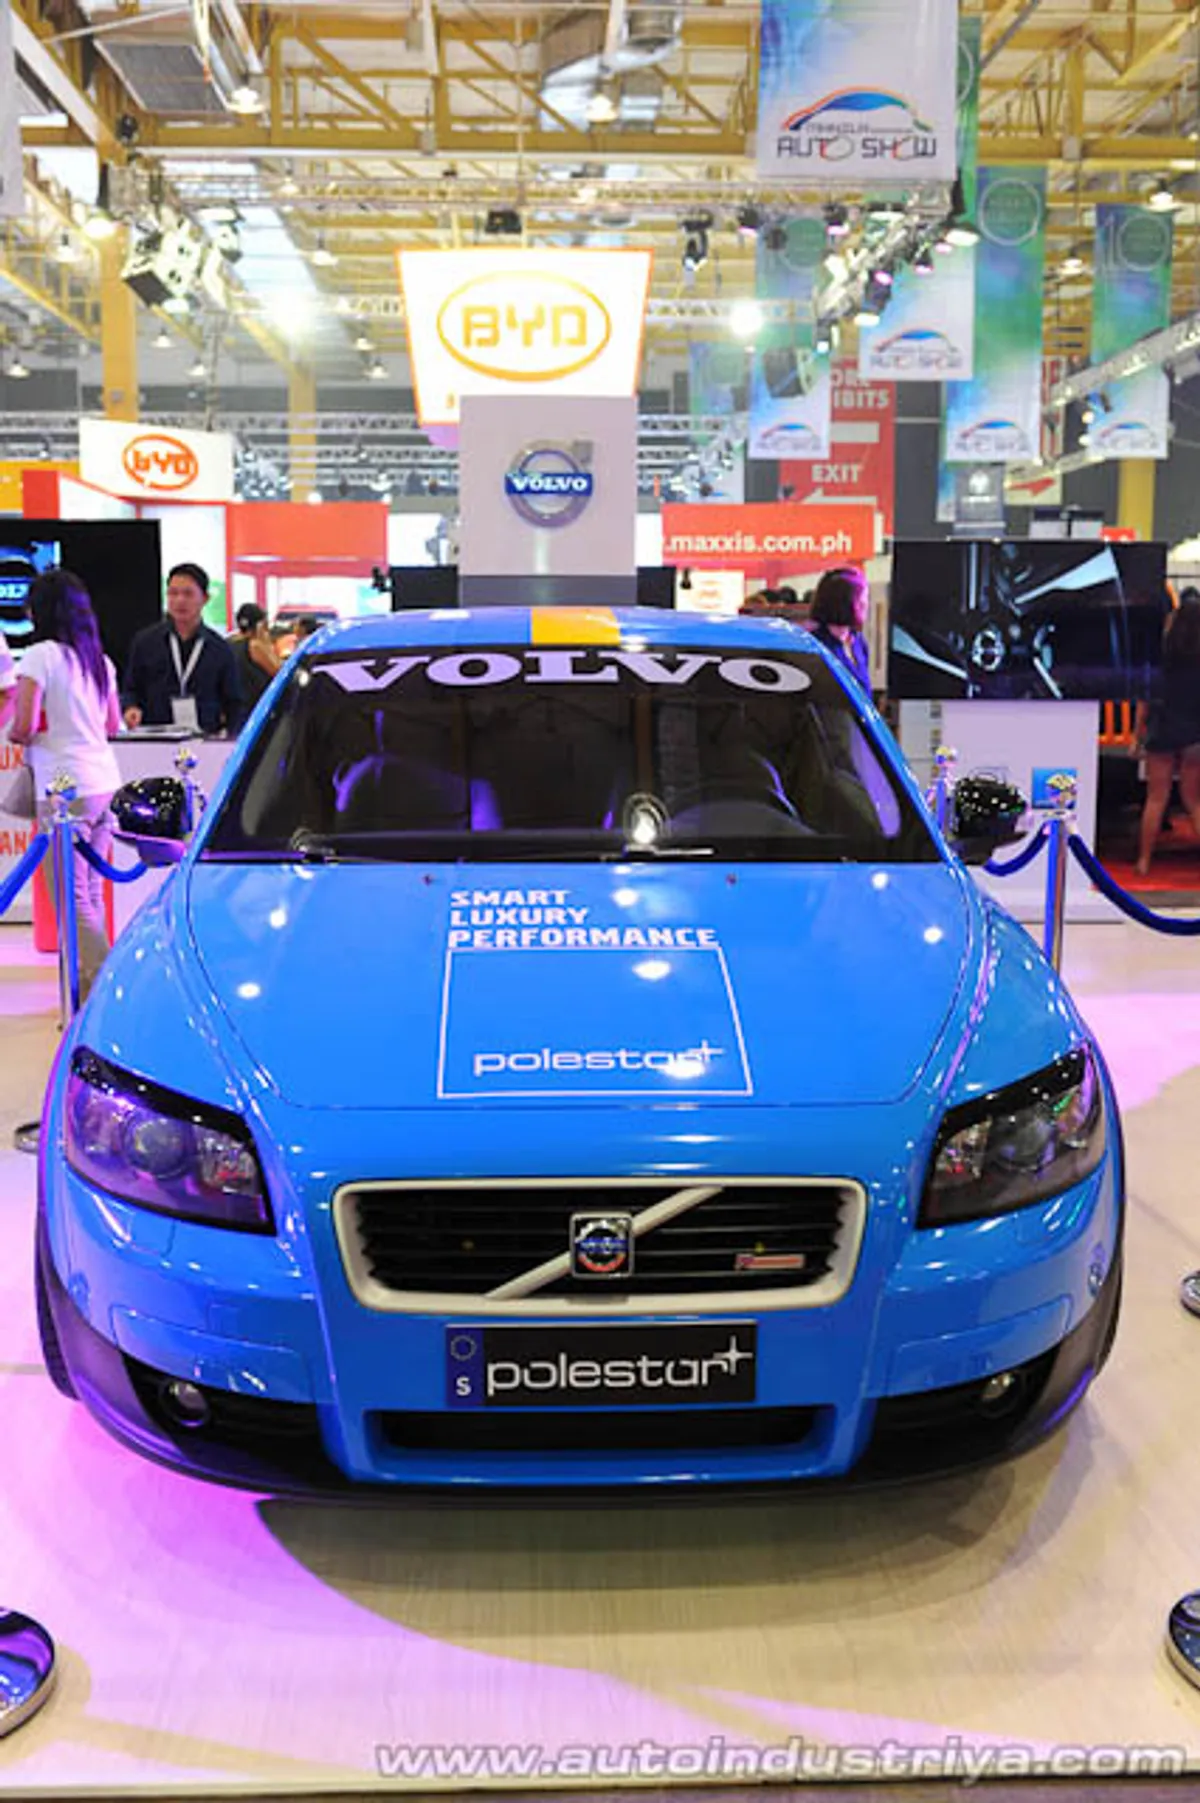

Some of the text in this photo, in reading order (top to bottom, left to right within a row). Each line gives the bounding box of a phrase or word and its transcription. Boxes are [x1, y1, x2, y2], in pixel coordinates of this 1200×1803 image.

[777, 136, 937, 161] AUTO SHOW
[461, 305, 589, 348] BYD
[811, 463, 860, 483] EXIT
[508, 475, 588, 492] VOLVO
[311, 650, 812, 693] VOLVO
[450, 889, 571, 907] SMART
[450, 907, 588, 926] LUXURY
[447, 927, 718, 948] PERFORMANCE
[456, 1376, 472, 1396] S
